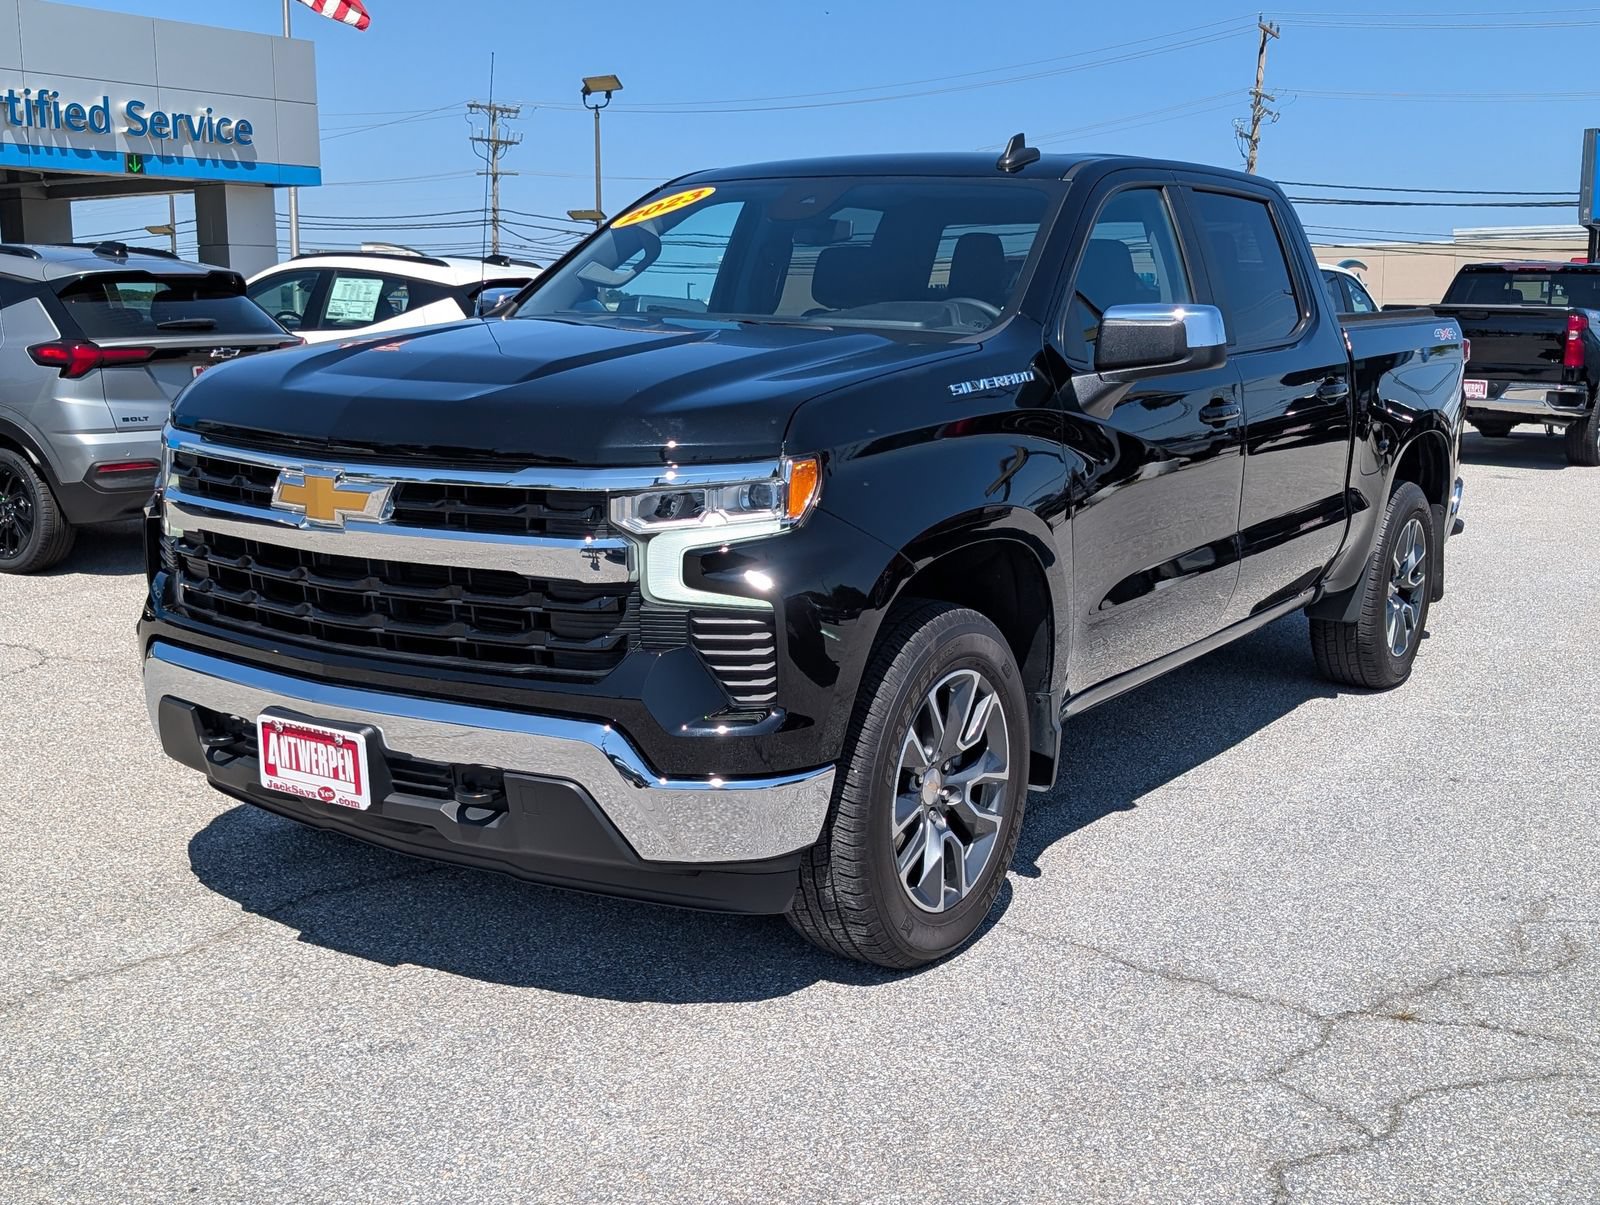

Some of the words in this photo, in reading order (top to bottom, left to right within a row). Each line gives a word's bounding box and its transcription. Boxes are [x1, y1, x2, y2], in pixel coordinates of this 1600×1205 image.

[0, 88, 111, 134] tified
[126, 100, 253, 145] Service
[619, 189, 706, 226] 2023
[948, 370, 1035, 396] SILVERADO
[122, 415, 149, 423] BOLT
[267, 731, 355, 784] ANTWERPEN
